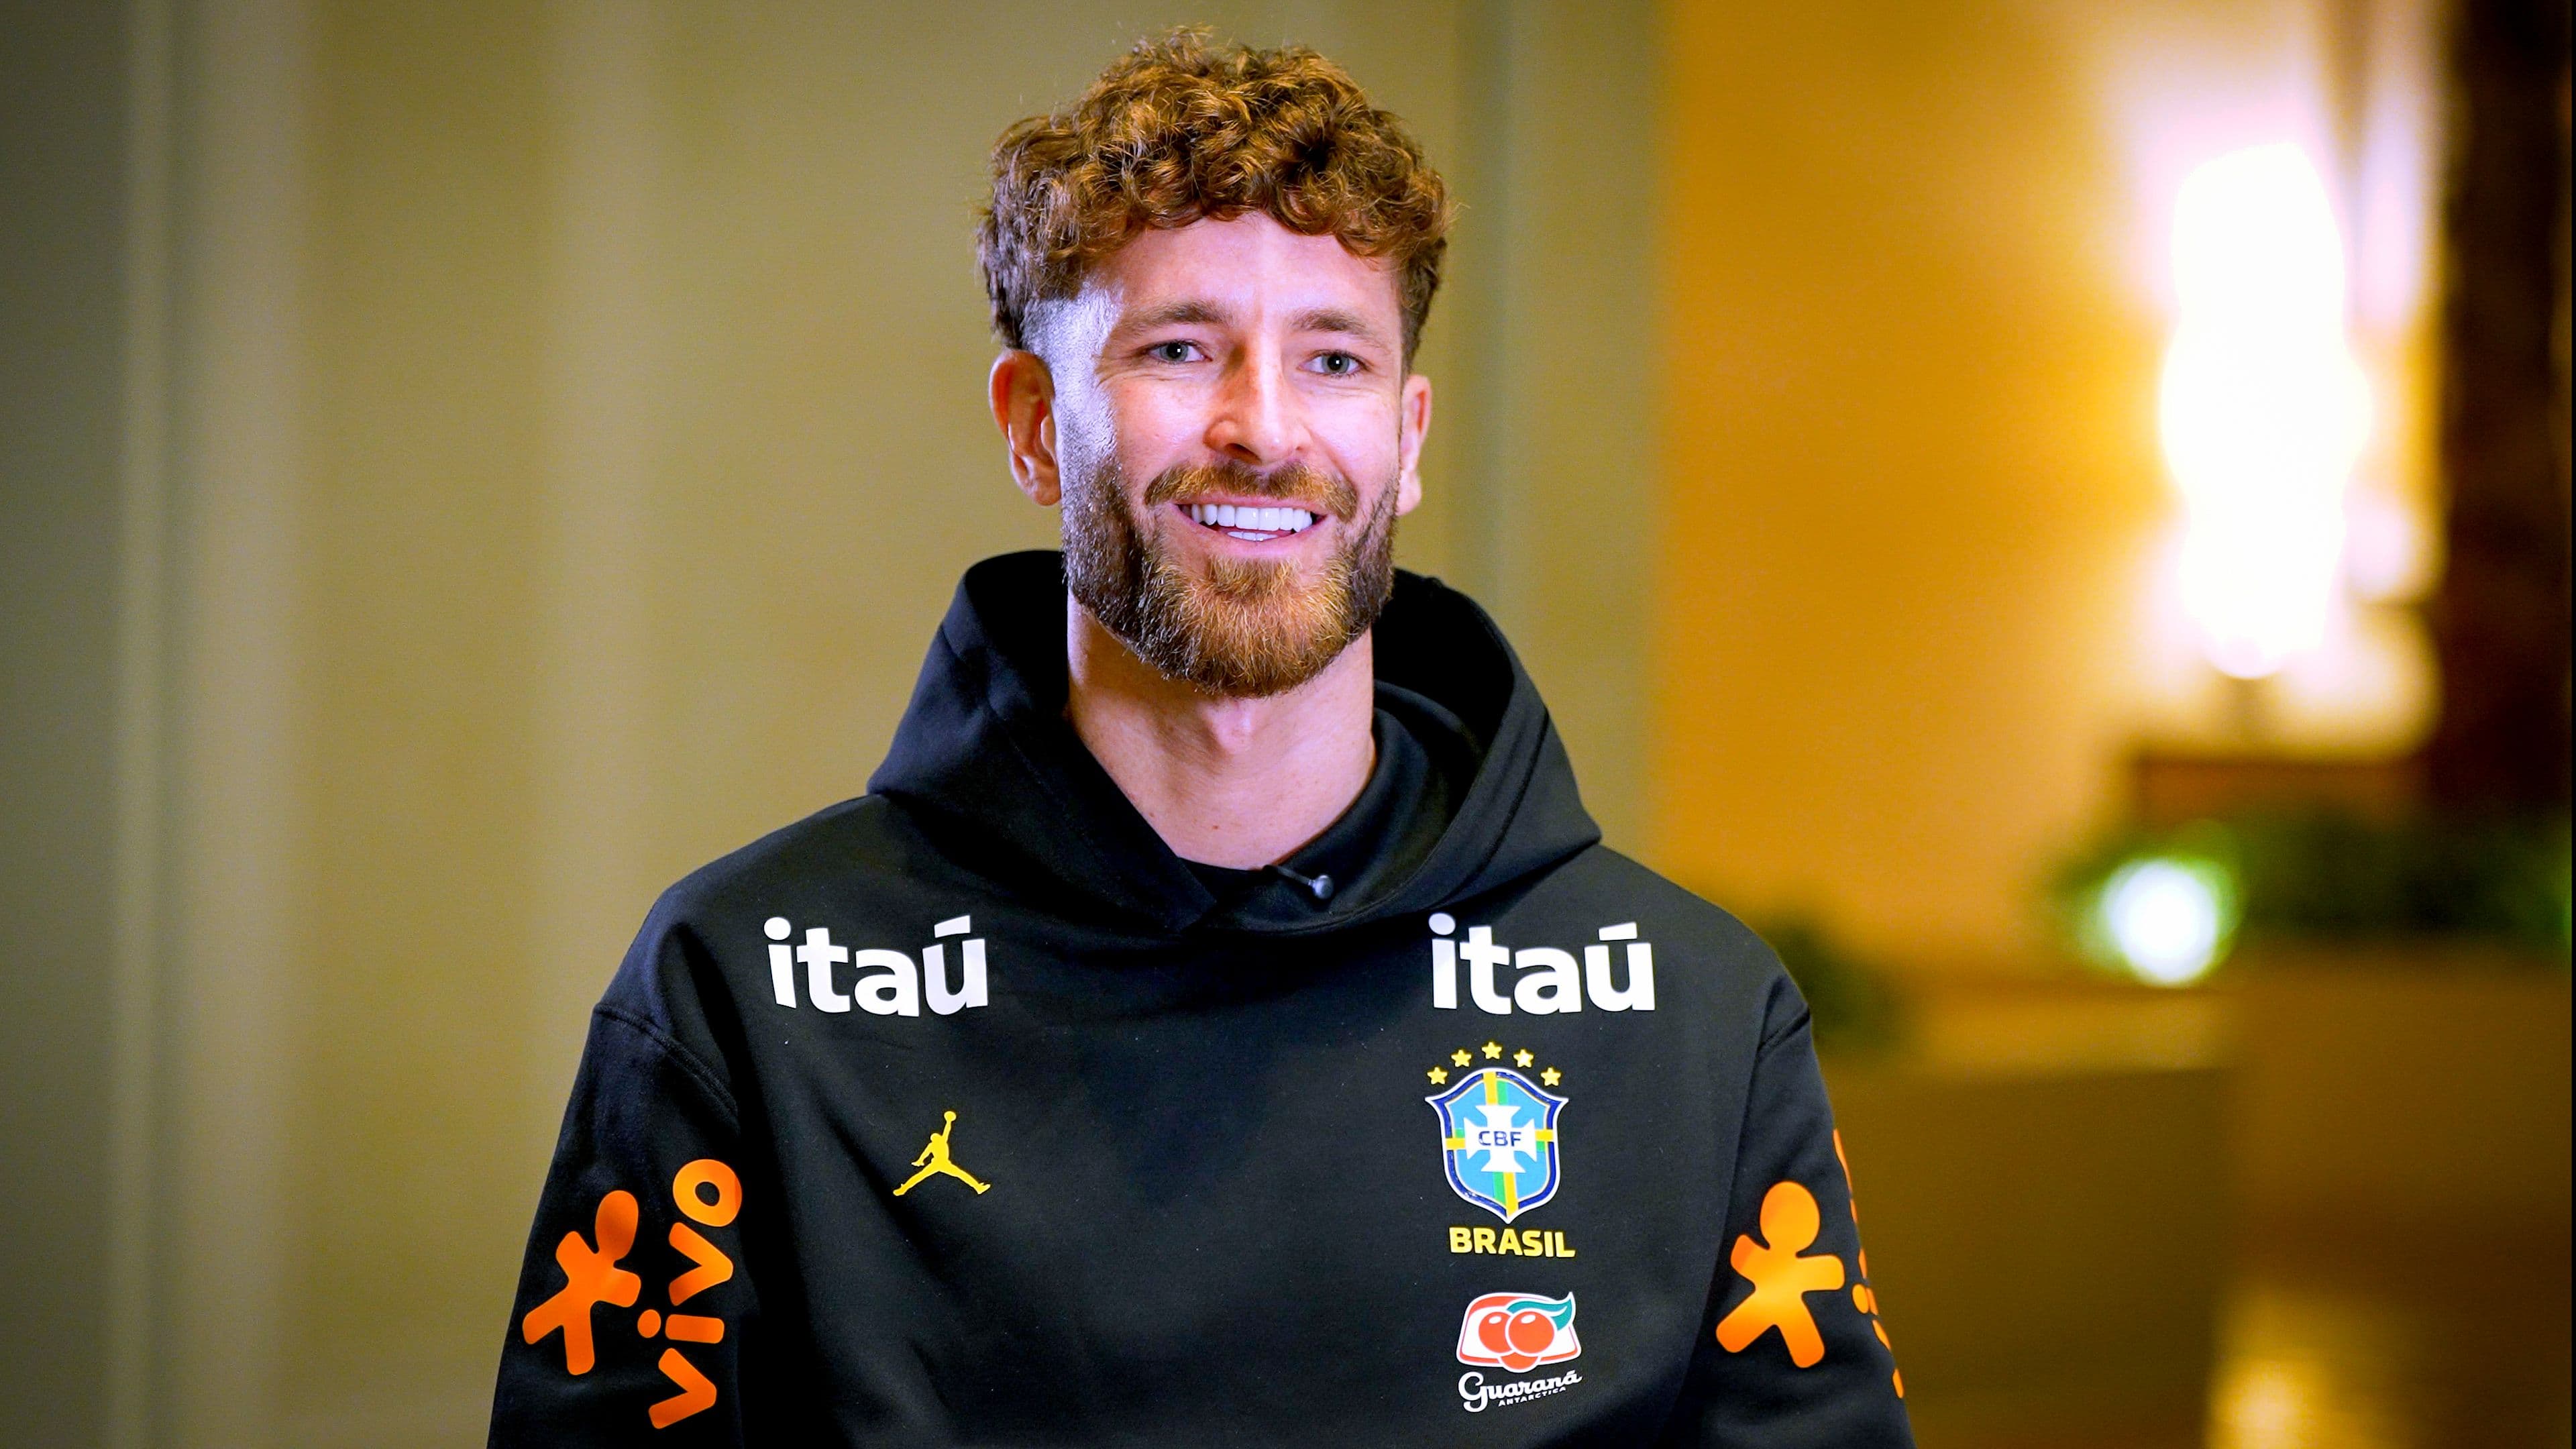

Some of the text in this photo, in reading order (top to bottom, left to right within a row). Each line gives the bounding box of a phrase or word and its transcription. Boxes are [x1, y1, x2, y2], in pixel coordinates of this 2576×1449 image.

[763, 914, 988, 1017] itaú
[1428, 913, 1655, 1015] itaú
[1479, 1131, 1521, 1147] CBF
[1449, 1226, 1576, 1258] BRASIL
[637, 1159, 742, 1429] vivo
[1458, 1370, 1582, 1412] Guaraná
[1498, 1387, 1566, 1407] ANTARCTICA
